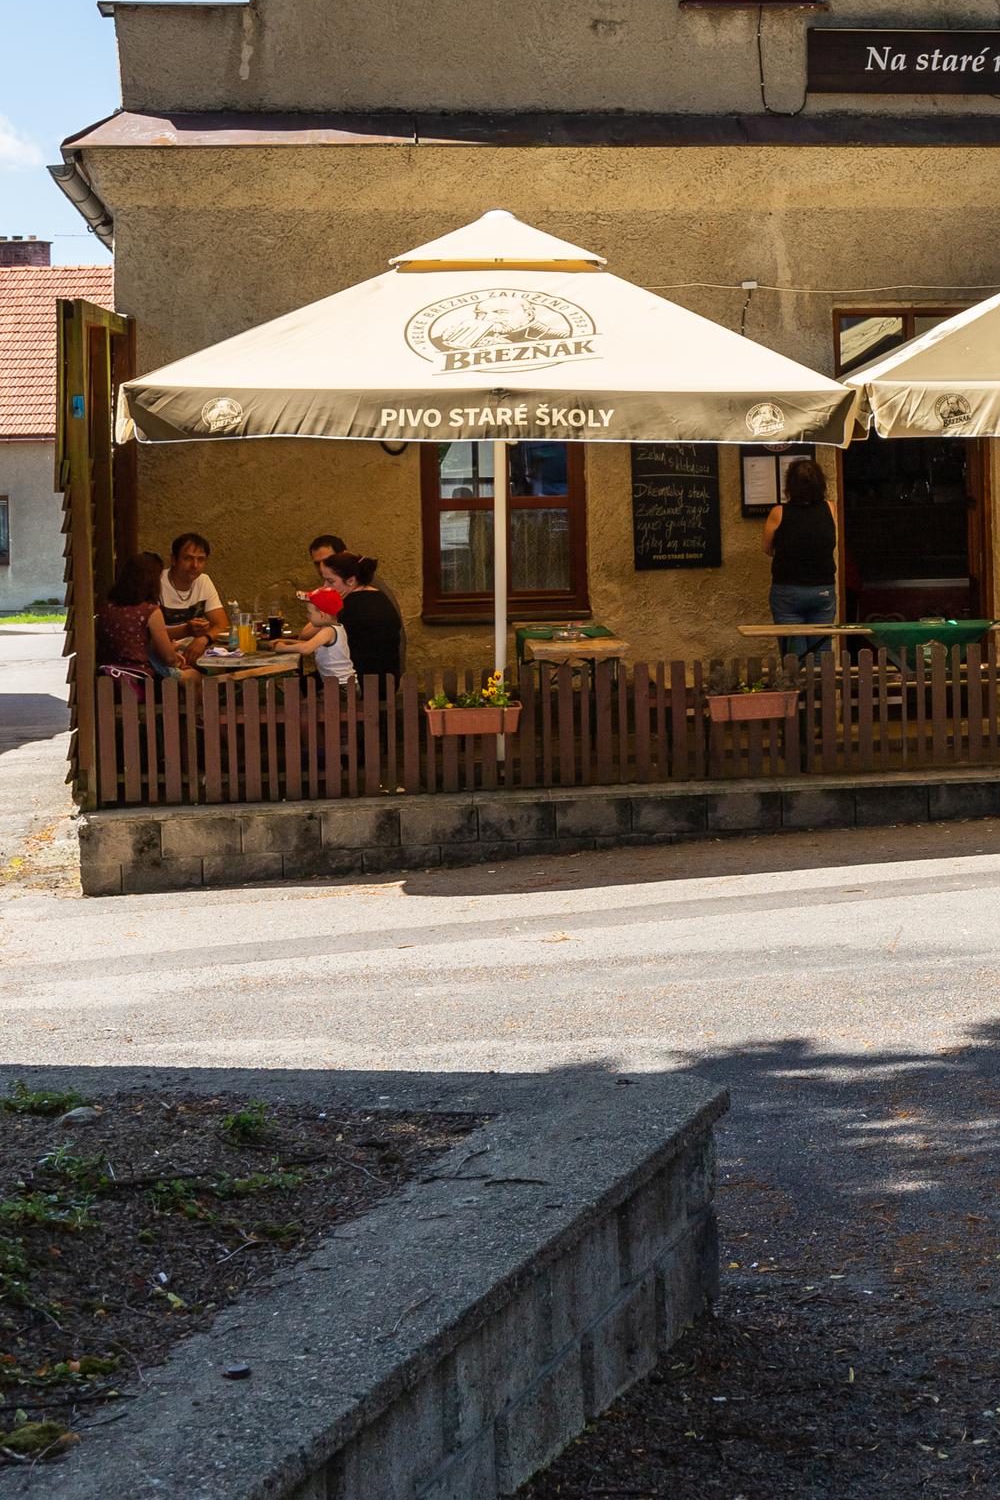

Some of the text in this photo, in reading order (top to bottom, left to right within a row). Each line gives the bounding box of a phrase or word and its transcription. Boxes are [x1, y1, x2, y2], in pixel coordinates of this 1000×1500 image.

[865, 46, 907, 71] Na
[916, 47, 990, 72] staré
[569, 311, 588, 329] 1753
[441, 339, 596, 371] BŘEZŇÁK
[380, 403, 614, 427] PIVO STARÉ ŠKOLY
